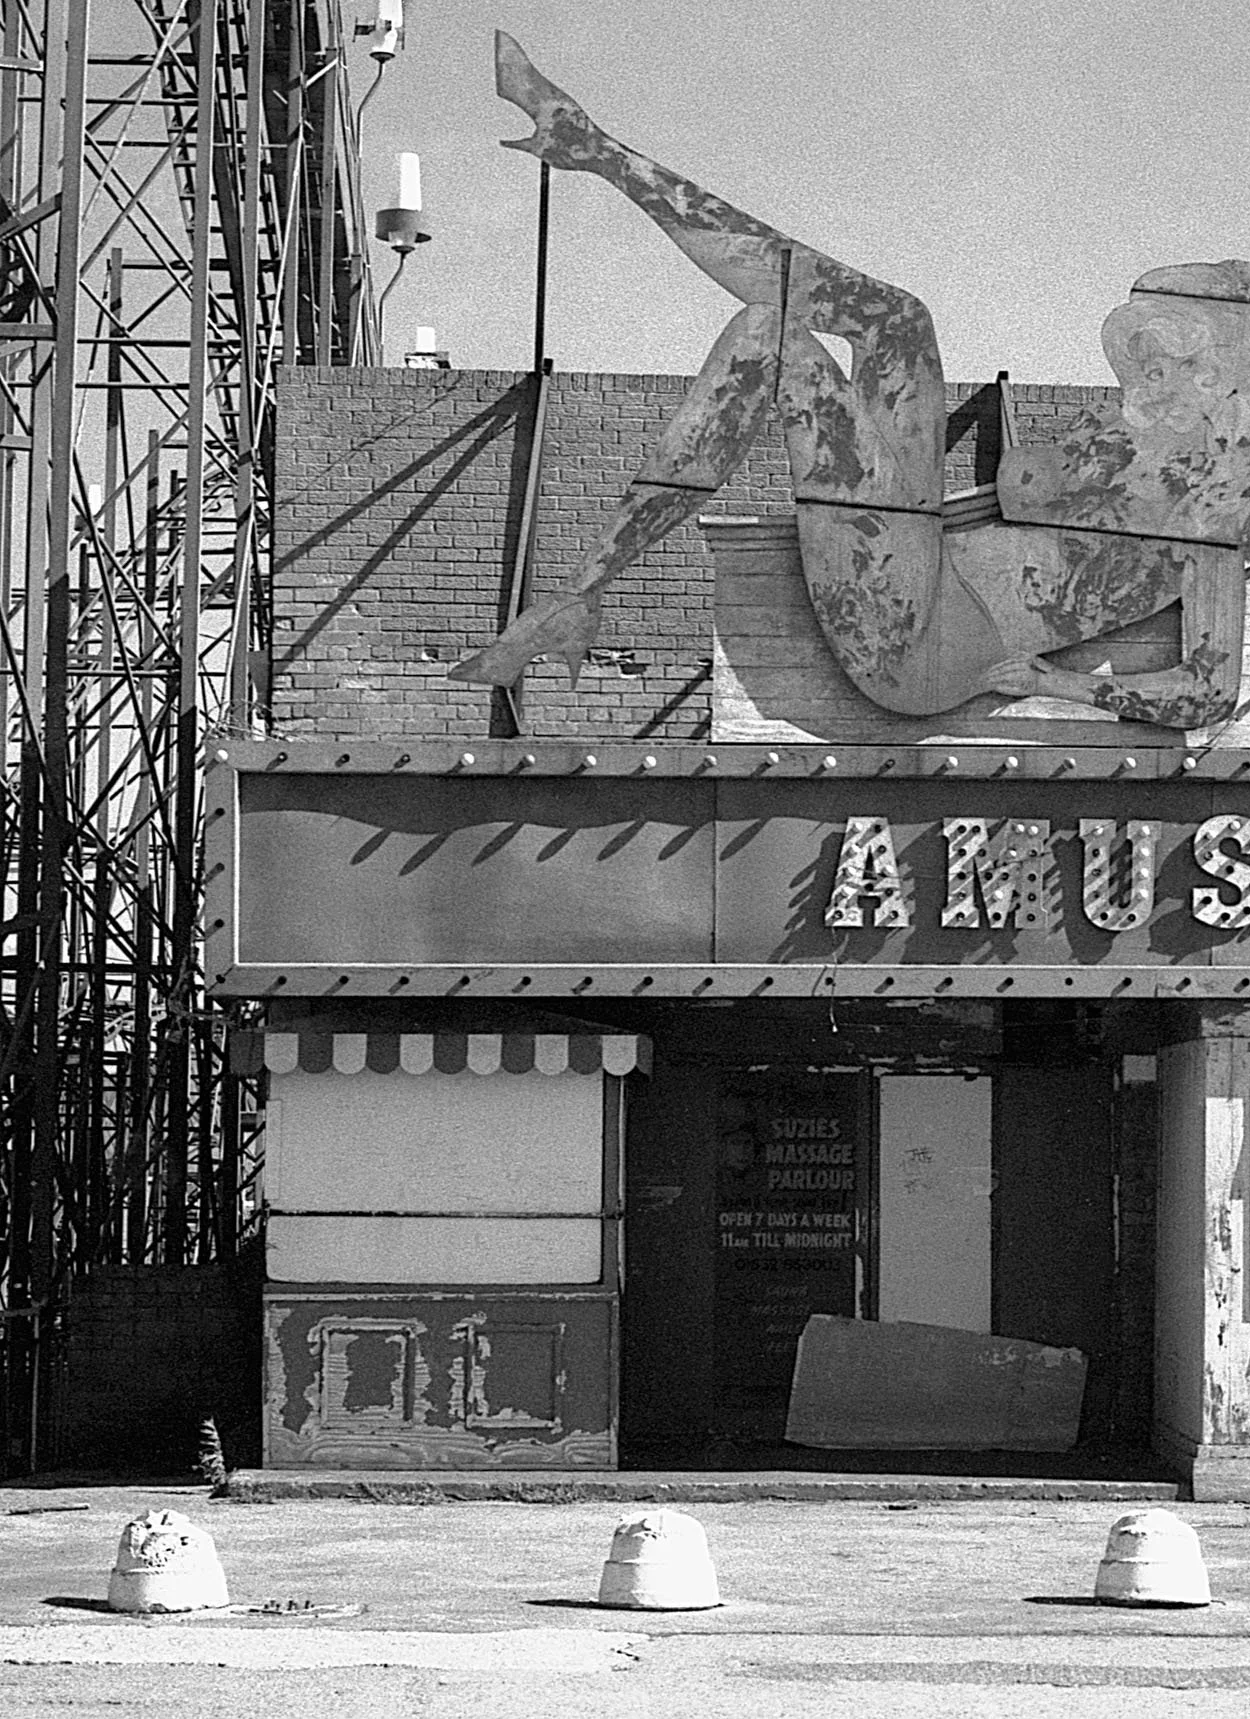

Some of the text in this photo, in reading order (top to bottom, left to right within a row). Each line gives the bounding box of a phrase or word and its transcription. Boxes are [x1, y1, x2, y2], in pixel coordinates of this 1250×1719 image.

[772, 1118, 841, 1139] SUZIES
[765, 1143, 853, 1165] MASSAGE
[768, 1169, 855, 1190] PARLOUR
[719, 1212, 851, 1228] OPEN 7 DAYS A WEEK
[752, 1232, 781, 1248] TILL
[784, 1232, 852, 1248] MIDNIGHT
